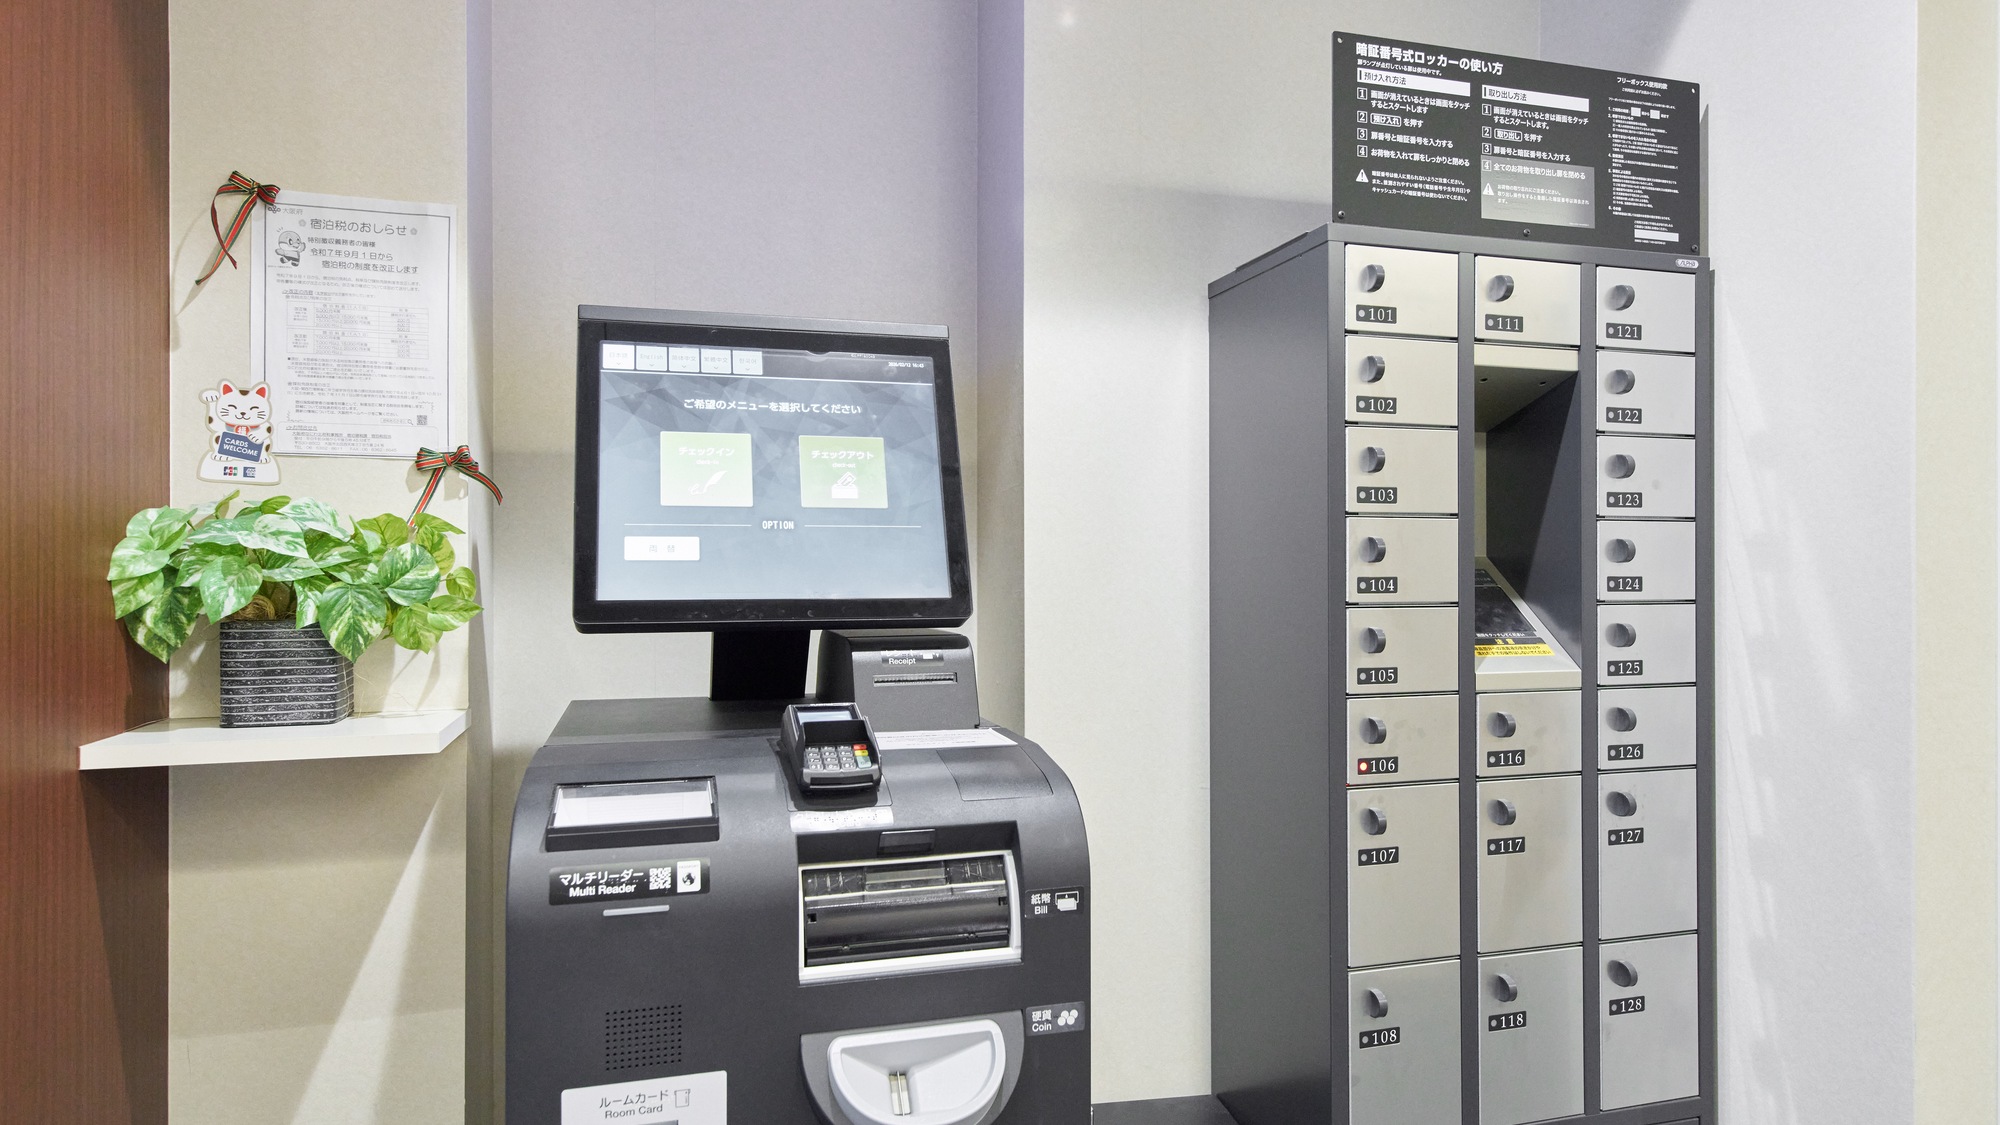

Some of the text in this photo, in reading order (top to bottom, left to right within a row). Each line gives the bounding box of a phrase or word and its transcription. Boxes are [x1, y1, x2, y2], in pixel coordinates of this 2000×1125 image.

[1355, 42, 1504, 75] 暗証番号式ロッカーの使い方
[1364, 72, 1407, 85] 預け入れ方法
[1371, 90, 1471, 110] 画面が消えているときは画面をタッチ
[1488, 89, 1527, 101] 取り出し方法
[1371, 101, 1429, 114] するとスタートします
[1493, 106, 1589, 125] 画面が消えているときは画面をタッチ
[1403, 119, 1424, 128] を押す
[1493, 116, 1550, 130] するとスタートします。
[1371, 131, 1454, 149] 扉番号と暗証番号を入力する
[1496, 131, 1521, 140] 取り出し
[1523, 133, 1543, 142] を押す
[1371, 148, 1470, 167] お荷物を入れて扉をしっかりと閉める
[1493, 145, 1571, 162] 扉番号と暗証番号を入力する
[1493, 162, 1586, 180] 全てのお荷物を取り出し扉を閉める
[310, 218, 407, 236] 宿泊税のおしらせ
[307, 236, 376, 248] 特別徴収義務者の皆様
[321, 260, 419, 274] 宿泊税の制度を改正します
[1368, 307, 1393, 322] 101
[1496, 317, 1520, 331] 111
[1616, 326, 1639, 338] 121
[683, 398, 861, 414] ご希望のメニューを選択してください
[1368, 399, 1394, 412] 102
[1616, 410, 1639, 422] 122
[224, 437, 249, 448] CARDS
[223, 443, 258, 457] WELCOME
[678, 446, 735, 457] チェックイン
[811, 450, 874, 460] チェックアウト
[1369, 489, 1394, 502] 103
[1617, 494, 1639, 506] 123
[762, 520, 794, 530] OPTION
[1369, 579, 1395, 592] 104
[1617, 578, 1640, 590] 124
[888, 657, 916, 666] Receipt
[1618, 662, 1640, 674] 125
[1369, 670, 1395, 683] 105
[1498, 752, 1523, 765] 116
[1618, 746, 1641, 759] 126
[1370, 759, 1396, 773] 106
[1618, 830, 1641, 843] 127
[1498, 839, 1523, 853] 117
[1370, 849, 1396, 863] 107
[559, 868, 644, 886] マルチリーダー
[569, 883, 636, 898] Multi Reader
[1031, 893, 1051, 905] 紙幣
[1034, 905, 1048, 915] Bill
[1619, 998, 1643, 1013] 128
[1032, 1009, 1052, 1022] 硬貨
[1499, 1013, 1524, 1028] 118
[1032, 1022, 1052, 1032] Coin
[1372, 1030, 1397, 1044] 108
[599, 1089, 669, 1109] ルームカード
[604, 1104, 663, 1119] Room Card
